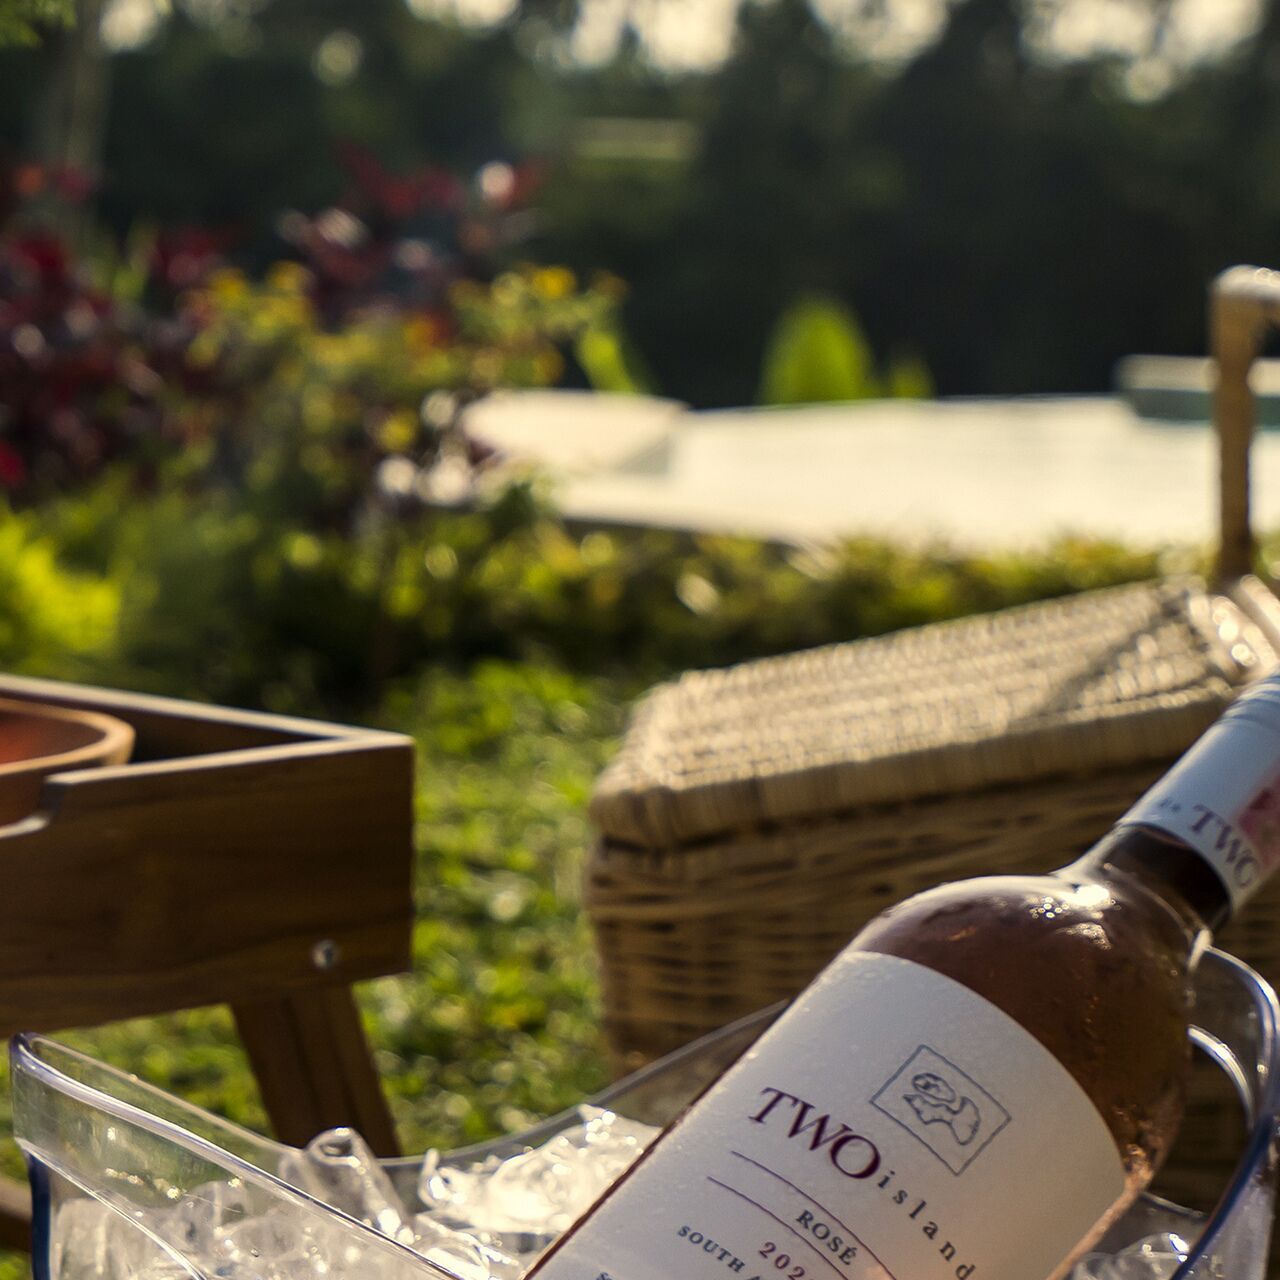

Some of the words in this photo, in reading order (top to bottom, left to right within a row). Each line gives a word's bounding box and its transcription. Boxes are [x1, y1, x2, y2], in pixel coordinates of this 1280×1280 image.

[748, 1086, 881, 1180] TWO
[677, 1225, 746, 1274] SOUTH
[795, 1209, 858, 1266] ROSÉ
